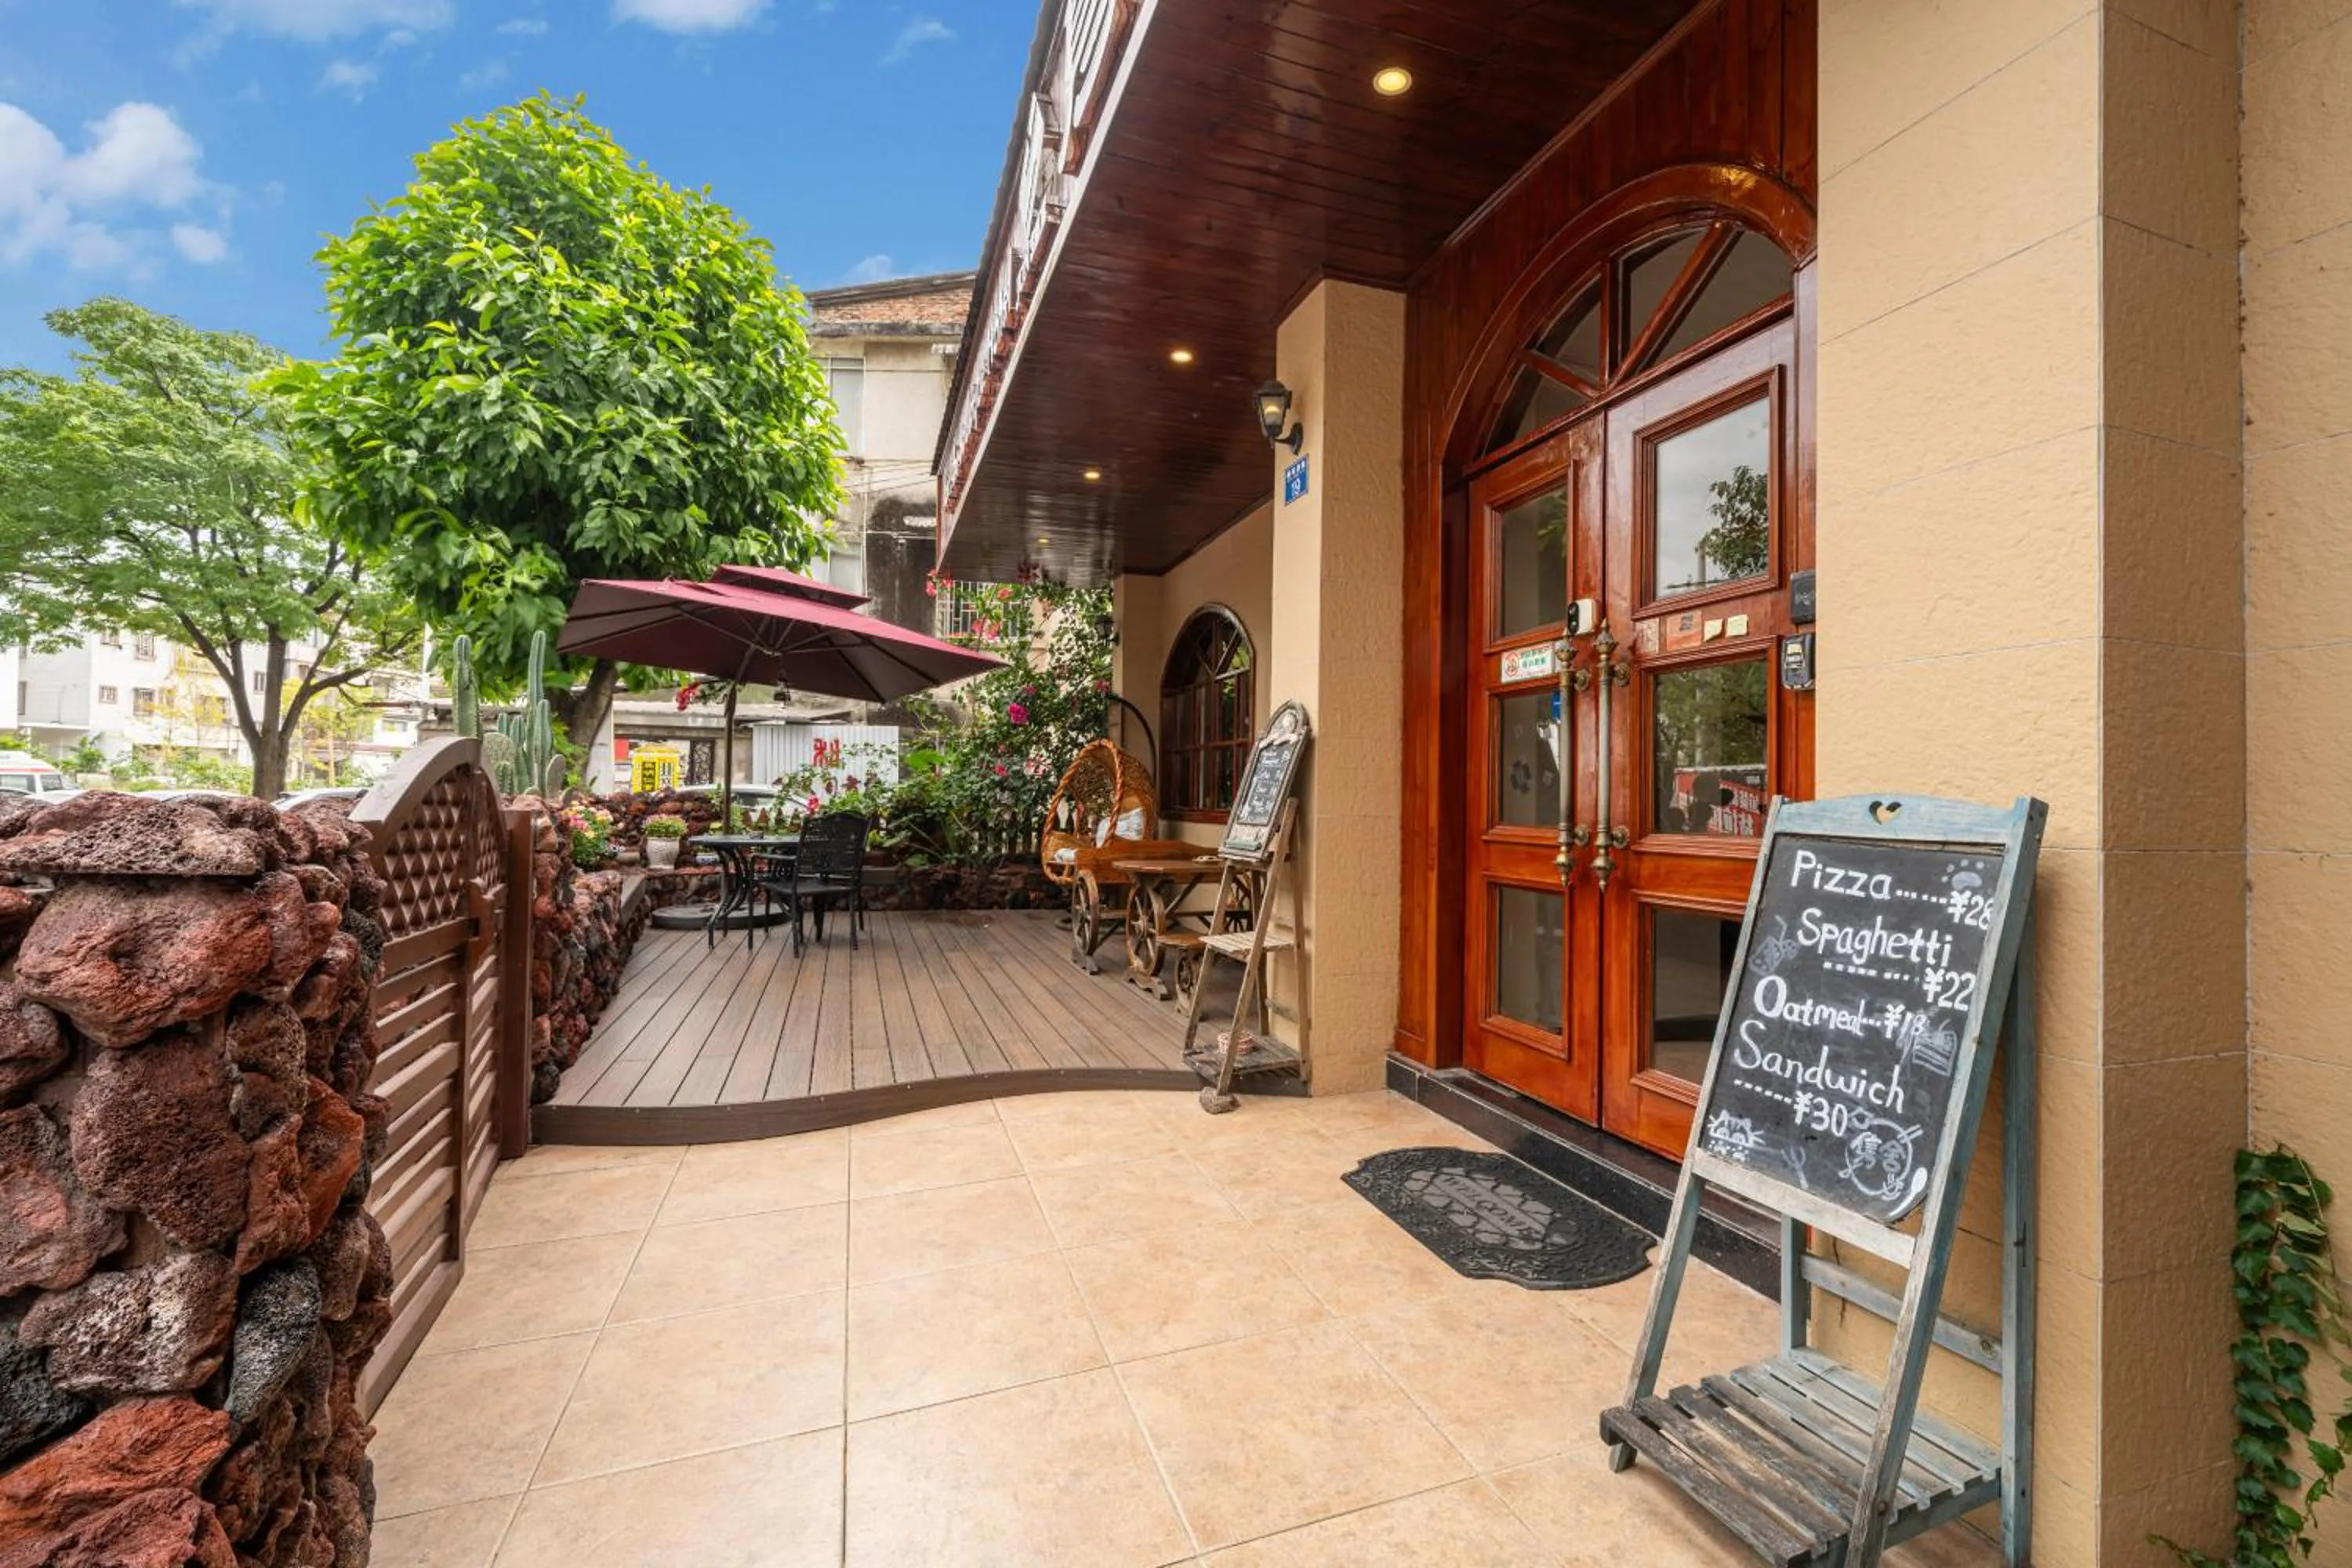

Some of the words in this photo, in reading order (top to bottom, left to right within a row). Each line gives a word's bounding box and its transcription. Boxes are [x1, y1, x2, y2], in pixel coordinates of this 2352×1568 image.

[1790, 849, 1892, 899] Pizza
[1797, 907, 1953, 967] Spaghetti
[1754, 975, 1865, 1036] Oatmeal
[1922, 967, 1976, 1011] ¥22
[1733, 1019, 1904, 1114] Sandwich
[1793, 1091, 1848, 1137] ¥30
[1441, 1176, 1541, 1239] WELCOME
